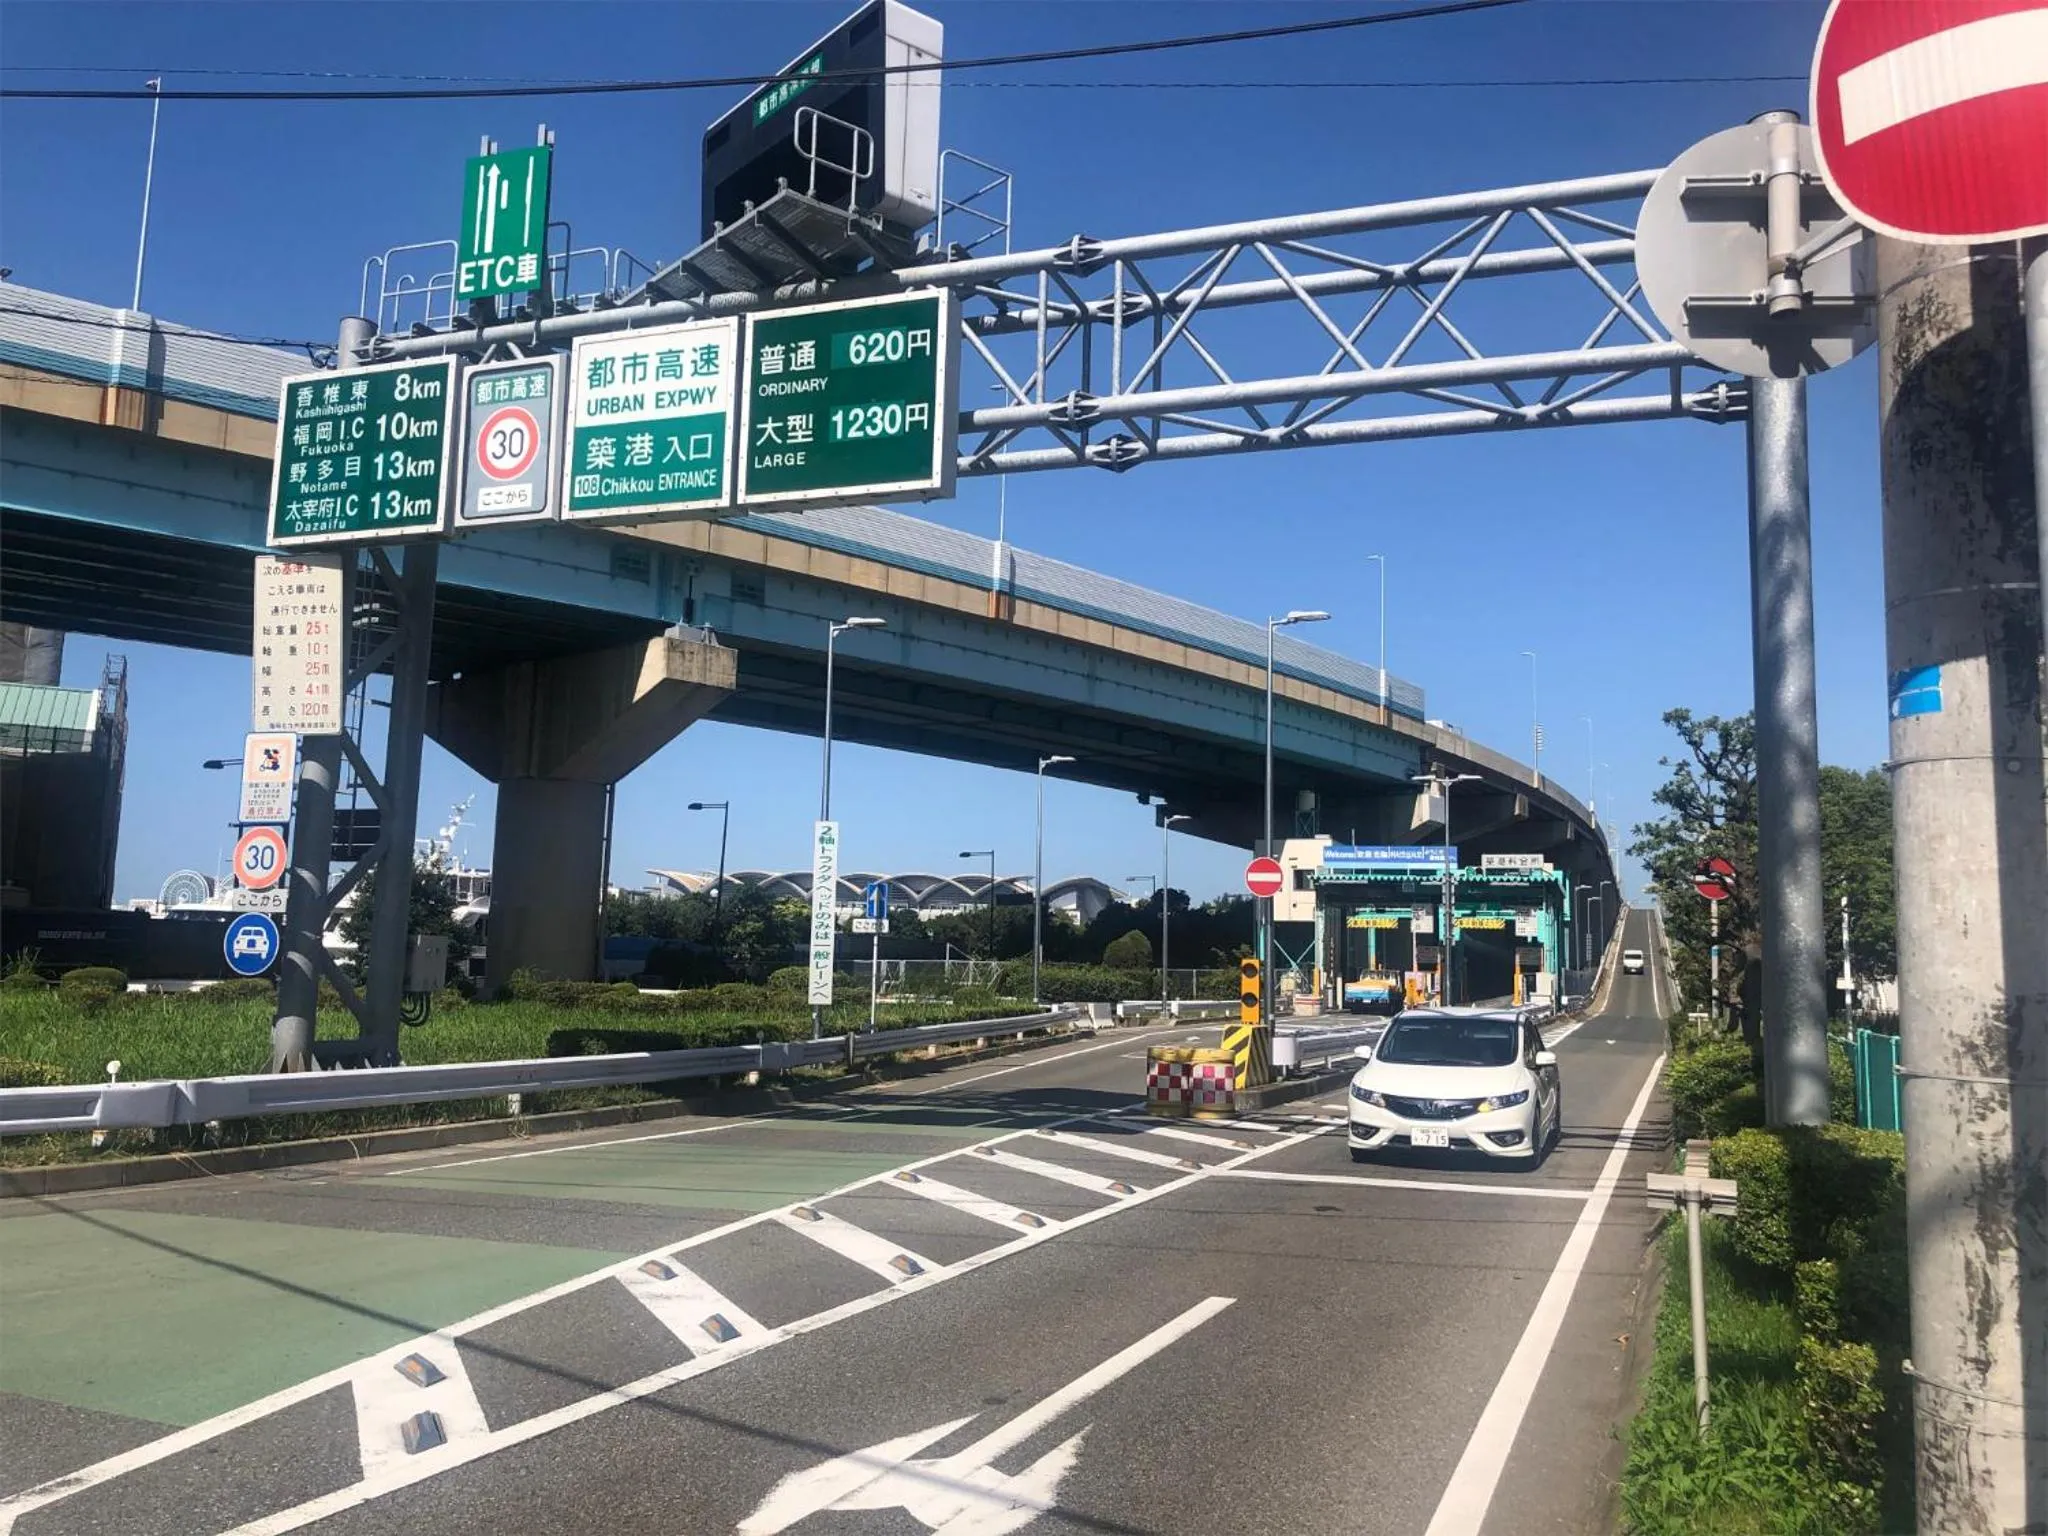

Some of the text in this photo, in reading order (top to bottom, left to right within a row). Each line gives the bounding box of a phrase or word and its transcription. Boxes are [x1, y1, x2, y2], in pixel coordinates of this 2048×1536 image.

[459, 253, 538, 293] ETC車
[760, 329, 931, 375] 普通 620円
[587, 343, 721, 389] 都市高速
[394, 373, 440, 401] 8km
[477, 376, 546, 403] 都市高速
[759, 376, 828, 398] ORDINARY
[296, 402, 366, 419] Kashiihigashi
[587, 386, 717, 416] URBAN EXPWY
[377, 411, 438, 441] 10km
[756, 403, 929, 446] 大型 1230円
[300, 441, 354, 456] Fukuoka
[492, 427, 525, 460] 30
[289, 451, 435, 483] 野多目 13km
[754, 452, 806, 469] LARGE
[301, 480, 348, 494] Notame
[577, 469, 717, 496] 108 Chikkou ENTRANCE
[371, 490, 431, 520] 13km
[482, 489, 527, 506] ここから
[295, 519, 346, 532] Dazaifu
[268, 584, 325, 596] こえる車両は
[271, 602, 338, 616] 通行できません
[246, 845, 275, 871] 30
[237, 895, 282, 908] ここから
